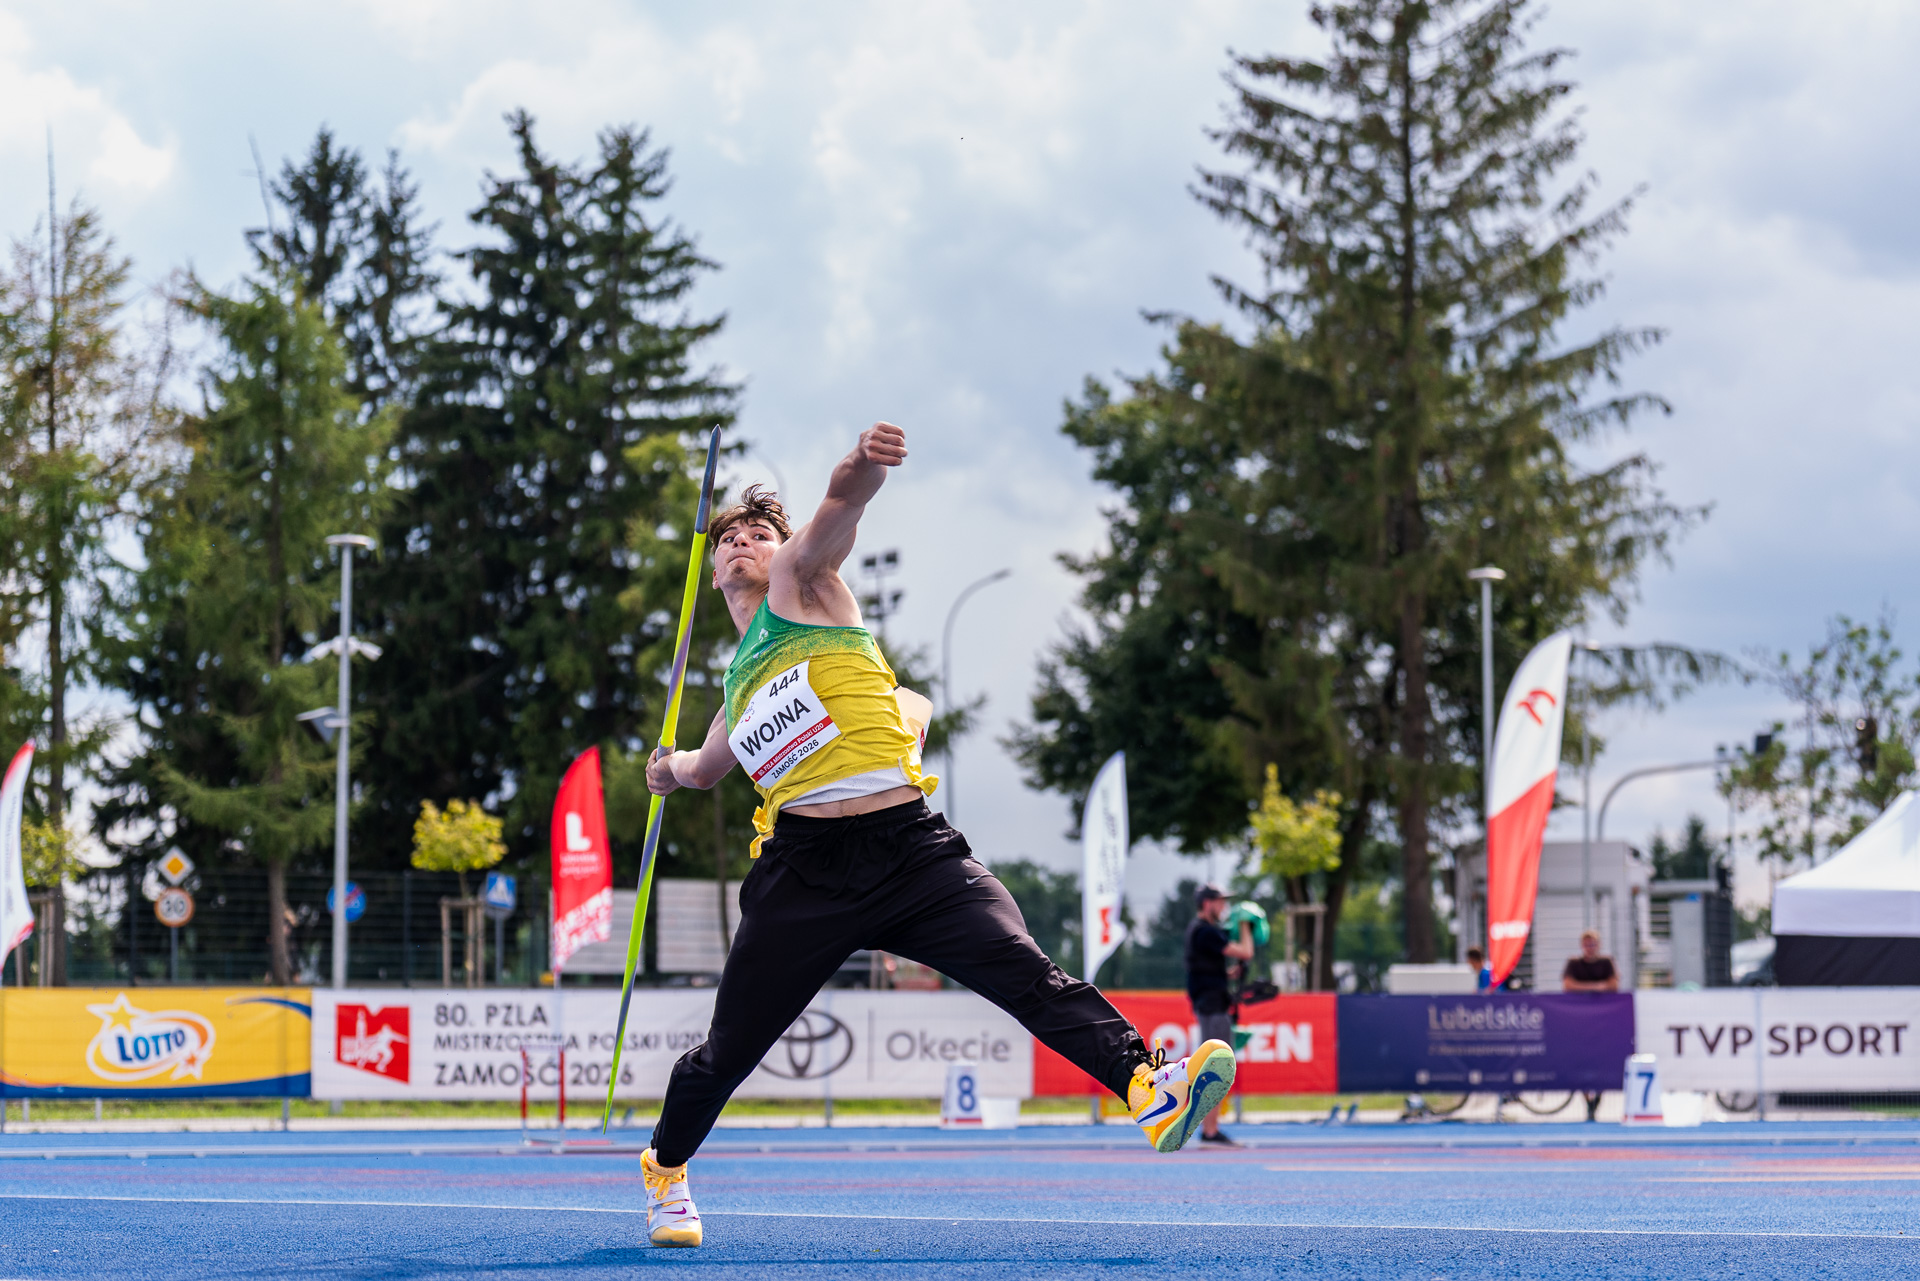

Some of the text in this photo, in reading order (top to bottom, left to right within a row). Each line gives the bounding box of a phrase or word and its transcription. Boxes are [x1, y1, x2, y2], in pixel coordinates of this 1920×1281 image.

[769, 669, 799, 698] 444
[740, 698, 811, 757] WOJNA
[773, 740, 798, 763] Mistrzostwa
[797, 730, 813, 744] Polski
[812, 722, 824, 733] U20
[771, 739, 819, 779] ZAMOŚĆ 2026
[435, 1004, 548, 1027] 80. PZLA
[1427, 1003, 1545, 1031] Lubelskie
[116, 1029, 186, 1063] LOTTO
[886, 1029, 1011, 1063] Okecie
[1150, 1021, 1313, 1063] OEN
[1667, 1024, 1908, 1056] TVP SPORT
[957, 1075, 976, 1113] 8
[1637, 1071, 1655, 1111] 7
